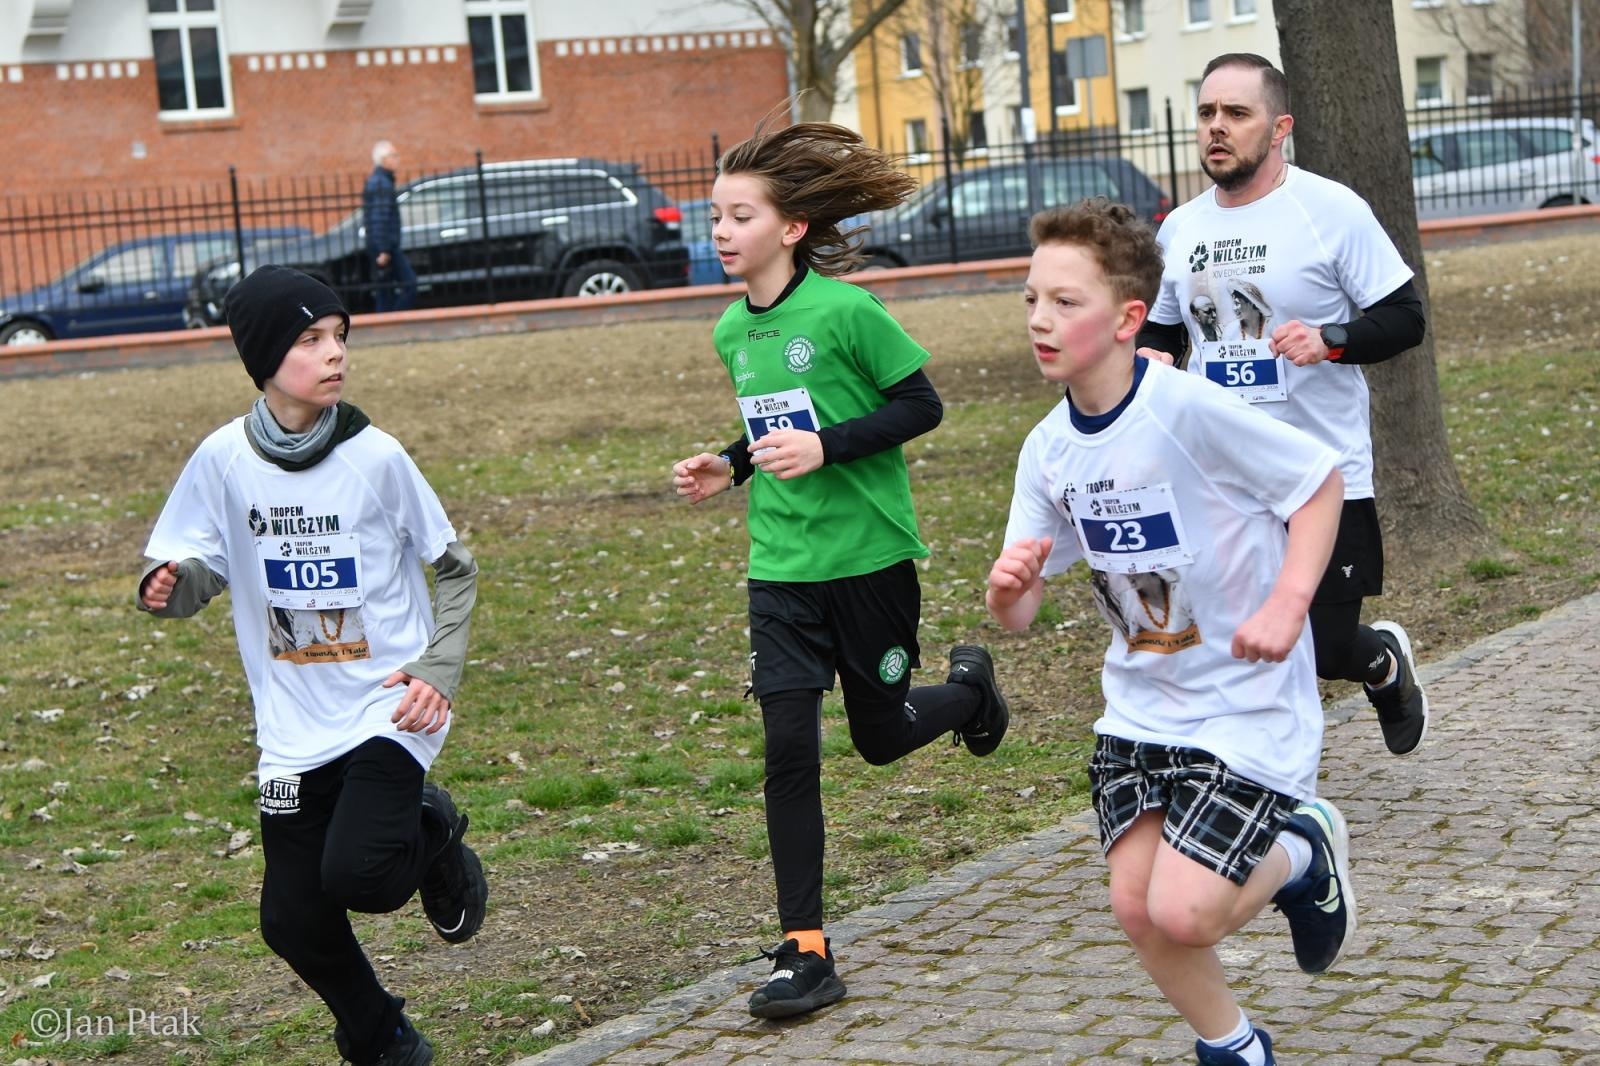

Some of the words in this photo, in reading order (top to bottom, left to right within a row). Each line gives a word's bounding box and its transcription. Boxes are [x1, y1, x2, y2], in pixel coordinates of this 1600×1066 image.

[1214, 238, 1242, 249] TROPEM
[1213, 244, 1267, 263] WILCZYM
[1248, 265, 1266, 274] 2026
[1228, 348, 1257, 357] WILCZYM
[1226, 362, 1256, 386] 56
[764, 400, 790, 412] WILCZYM
[1086, 478, 1115, 494] TROPEM
[270, 506, 304, 518] TROPEM
[1104, 502, 1142, 515] WILCZYM
[271, 515, 340, 536] WILCZYM
[1104, 521, 1147, 551] 23
[296, 546, 331, 556] WILCZYM
[284, 561, 340, 589] 105
[272, 782, 300, 799] FUN
[265, 797, 300, 808] YOURSELF
